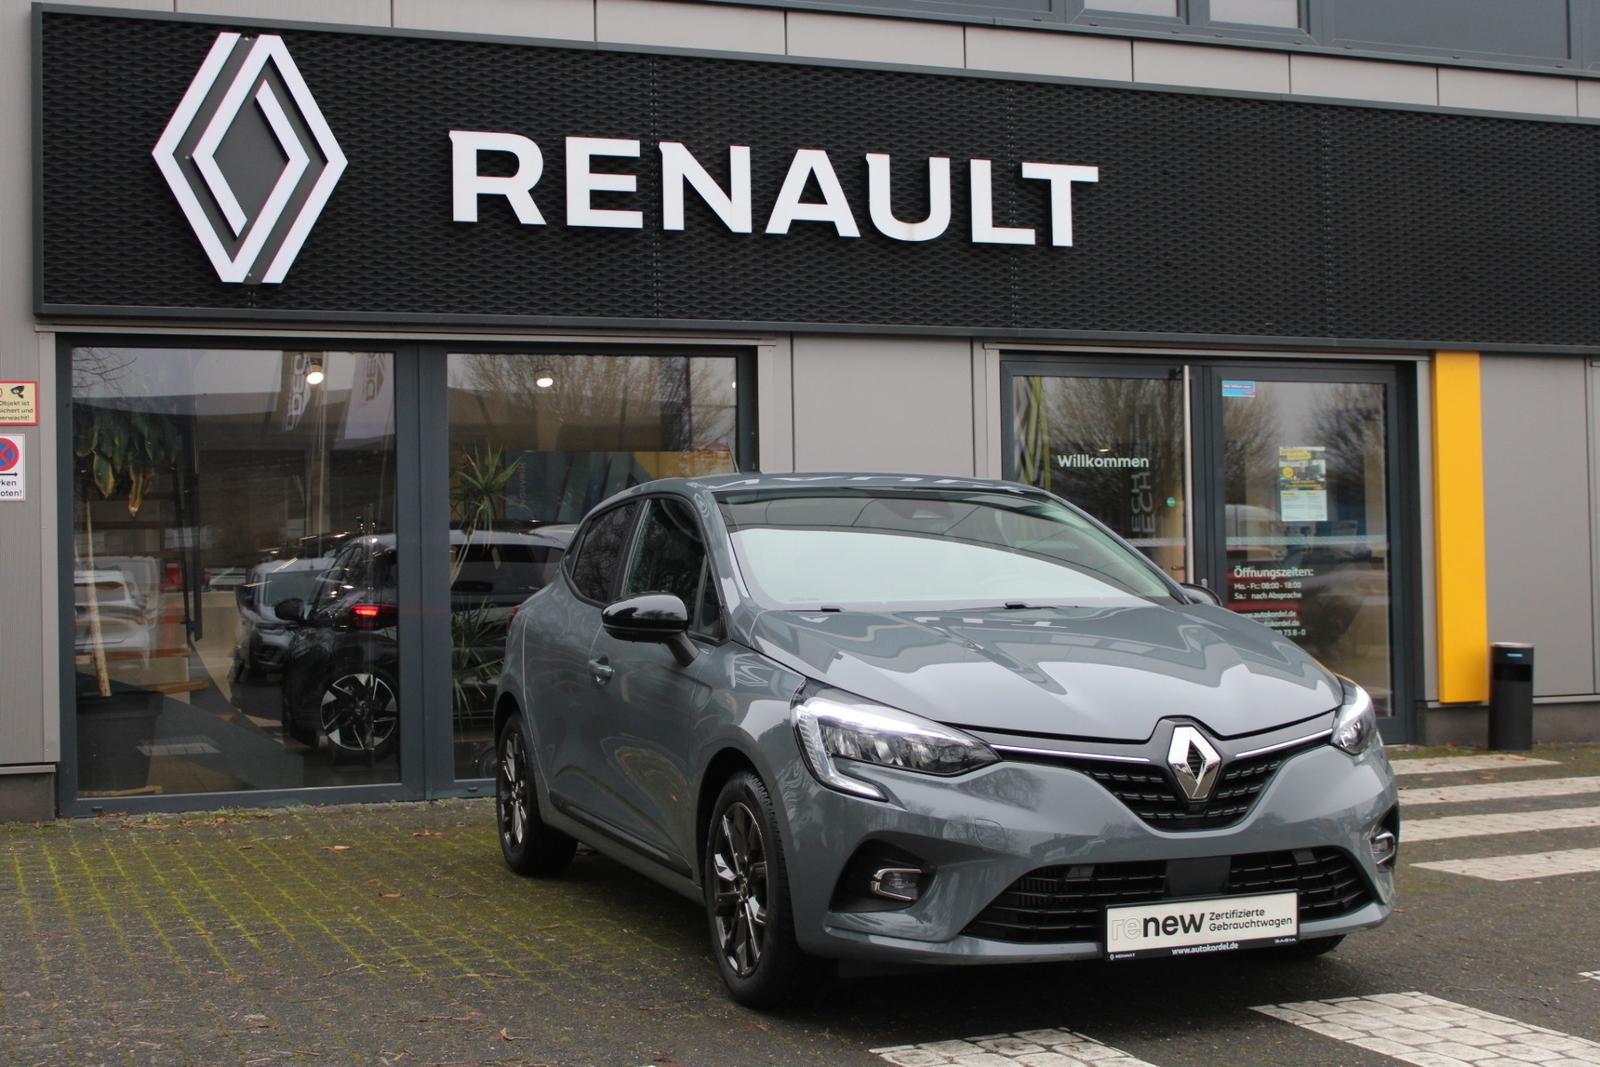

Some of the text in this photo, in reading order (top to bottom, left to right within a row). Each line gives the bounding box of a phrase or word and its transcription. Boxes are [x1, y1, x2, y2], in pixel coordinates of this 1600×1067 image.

[449, 129, 1099, 248] RENAULT
[1057, 455, 1150, 468] Willkommen
[1233, 565, 1314, 580] Öffnungszeiten:
[1251, 591, 1268, 600] nach
[1268, 591, 1302, 601] Absprache
[1209, 908, 1265, 921] Zertifizierte
[1111, 913, 1205, 941] renew
[1209, 917, 1293, 932] Gebrauchtwagen
[1171, 942, 1239, 955] www.autokordel.de
